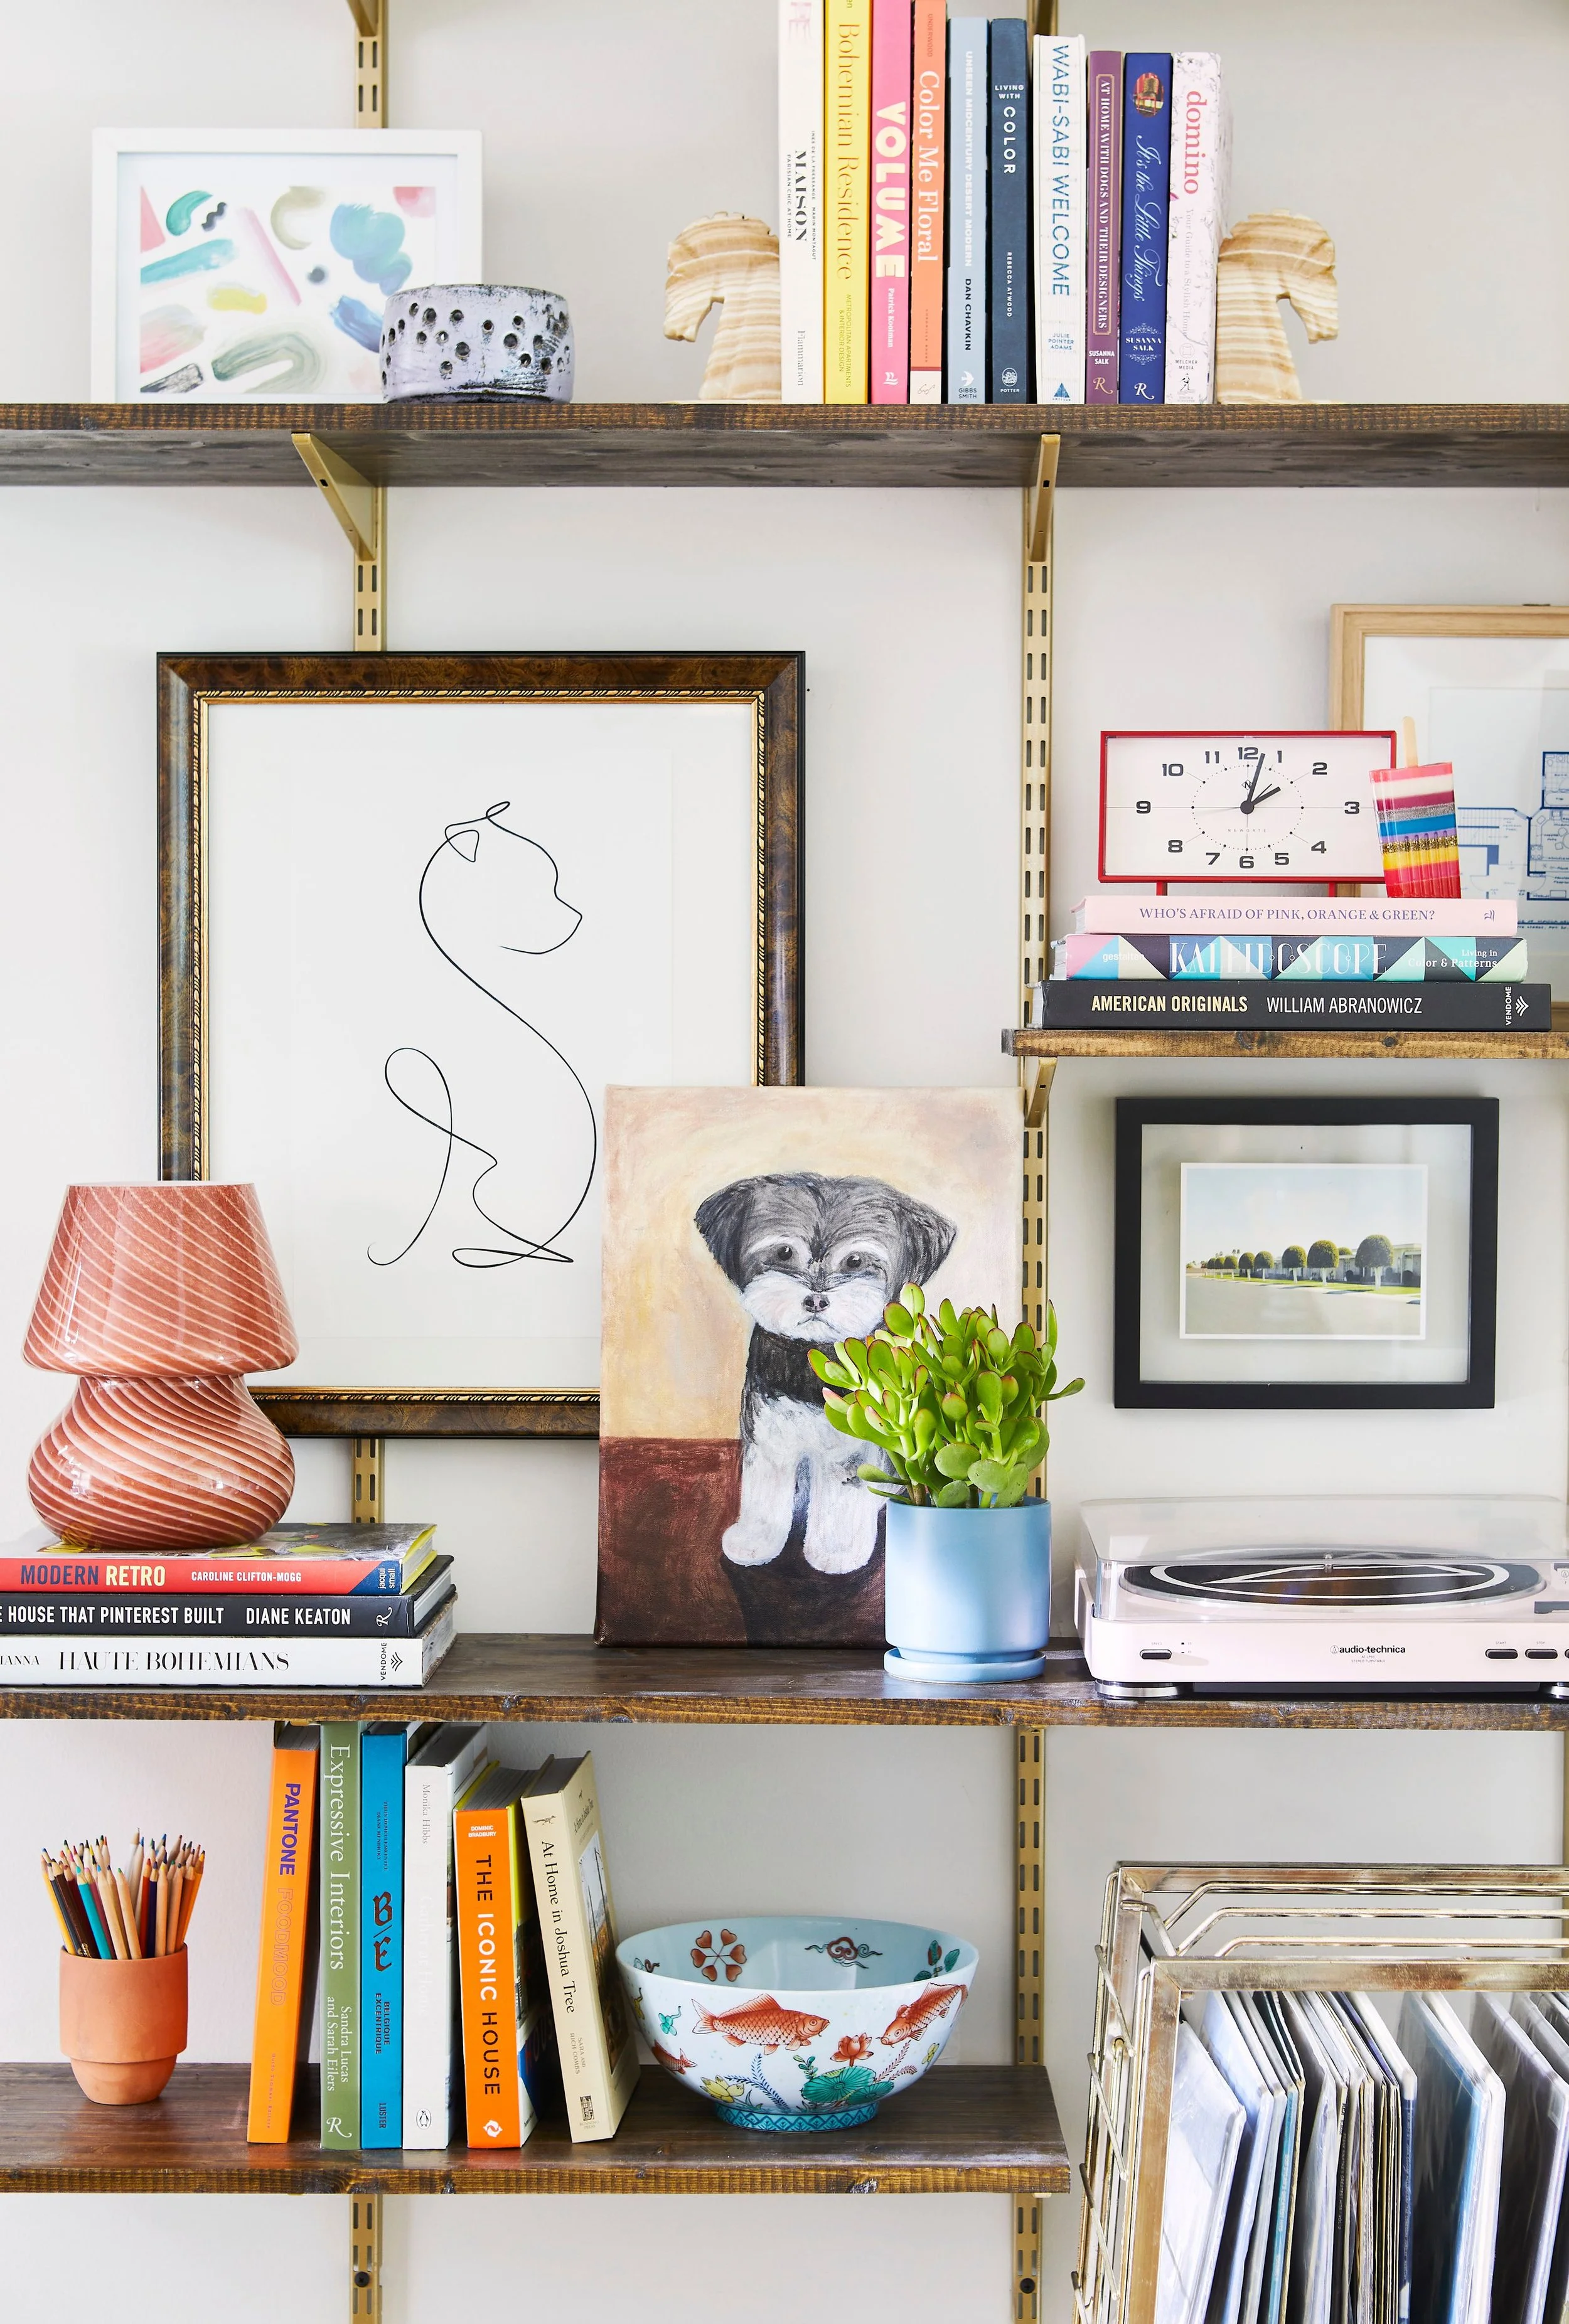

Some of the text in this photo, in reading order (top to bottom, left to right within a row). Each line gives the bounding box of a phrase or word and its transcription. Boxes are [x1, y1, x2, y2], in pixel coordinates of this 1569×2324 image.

[837, 24, 860, 279] Bohemian Residence
[1004, 106, 1016, 174] COLOR
[1184, 91, 1208, 195] domino
[918, 70, 940, 262] Color Me Floral
[1052, 45, 1069, 296] WABI-SABI WELCOME
[795, 151, 806, 241] MAISON
[876, 102, 906, 278] VOLUME
[1098, 80, 1111, 329] AT HOME WITH DOGS AND THEIR DESIGNERS
[1125, 135, 1163, 302] It's the Little Things
[1185, 208, 1194, 230] Your
[1184, 231, 1193, 259] Guide
[1182, 278, 1192, 308] Stylish
[1182, 311, 1191, 337] Home
[797, 331, 806, 386] Flammarion
[1205, 751, 1219, 764] 11
[1238, 747, 1258, 760] 12
[1277, 750, 1282, 763] 1
[1162, 764, 1184, 776] 10
[1312, 762, 1327, 775] 2
[1136, 801, 1151, 814] 9
[1344, 801, 1360, 814] 3
[1168, 840, 1183, 853] 8
[1206, 853, 1220, 865] 7
[1275, 853, 1290, 865] 5
[1311, 841, 1327, 854] 4
[1239, 856, 1254, 869] 6
[1189, 909, 1242, 919] AFRAID
[1245, 909, 1263, 919] OF
[1267, 909, 1304, 921] PINK,
[1307, 909, 1367, 920] ORANGE
[1369, 909, 1379, 920] &
[1382, 909, 1435, 920] GREEN?
[1169, 942, 1388, 974] KALEIDOSCOPE
[1408, 958, 1497, 968] Color & Patterns
[1462, 949, 1487, 957] Living
[1091, 995, 1422, 1015] AMERICAN ORIGINALS WILLIAM ABRANOWICZ
[21, 1565, 301, 1586] MODERN RETRO CAROLINE CLIFTON-MOGG
[378, 1568, 386, 1589] jacqui
[8, 1606, 55, 1623] HOUSE
[60, 1606, 95, 1623] THAT
[100, 1607, 178, 1624] PINTEREST
[184, 1607, 224, 1624] BUILT
[246, 1607, 289, 1624] DIANE
[294, 1608, 351, 1625] KEATON
[60, 1651, 138, 1670] HAUTE
[147, 1652, 289, 1671] BOHEMIANS
[1339, 1645, 1406, 1653] audio-technica
[422, 1784, 431, 1845] Monika Hibbs
[323, 1743, 351, 1970] Expressive Interiors
[270, 1783, 301, 2006] PANTONE FOODMOOD
[542, 1841, 577, 2013] At Home in Joshua Tree
[476, 1855, 500, 2095] THE ICONIC HOUSE
[326, 1996, 338, 2091] and Sarah Eilers
[340, 2006, 353, 2082] Sandra Lucas
[572, 2050, 581, 2075] COMBS
[378, 2103, 387, 2128] LUSTER
